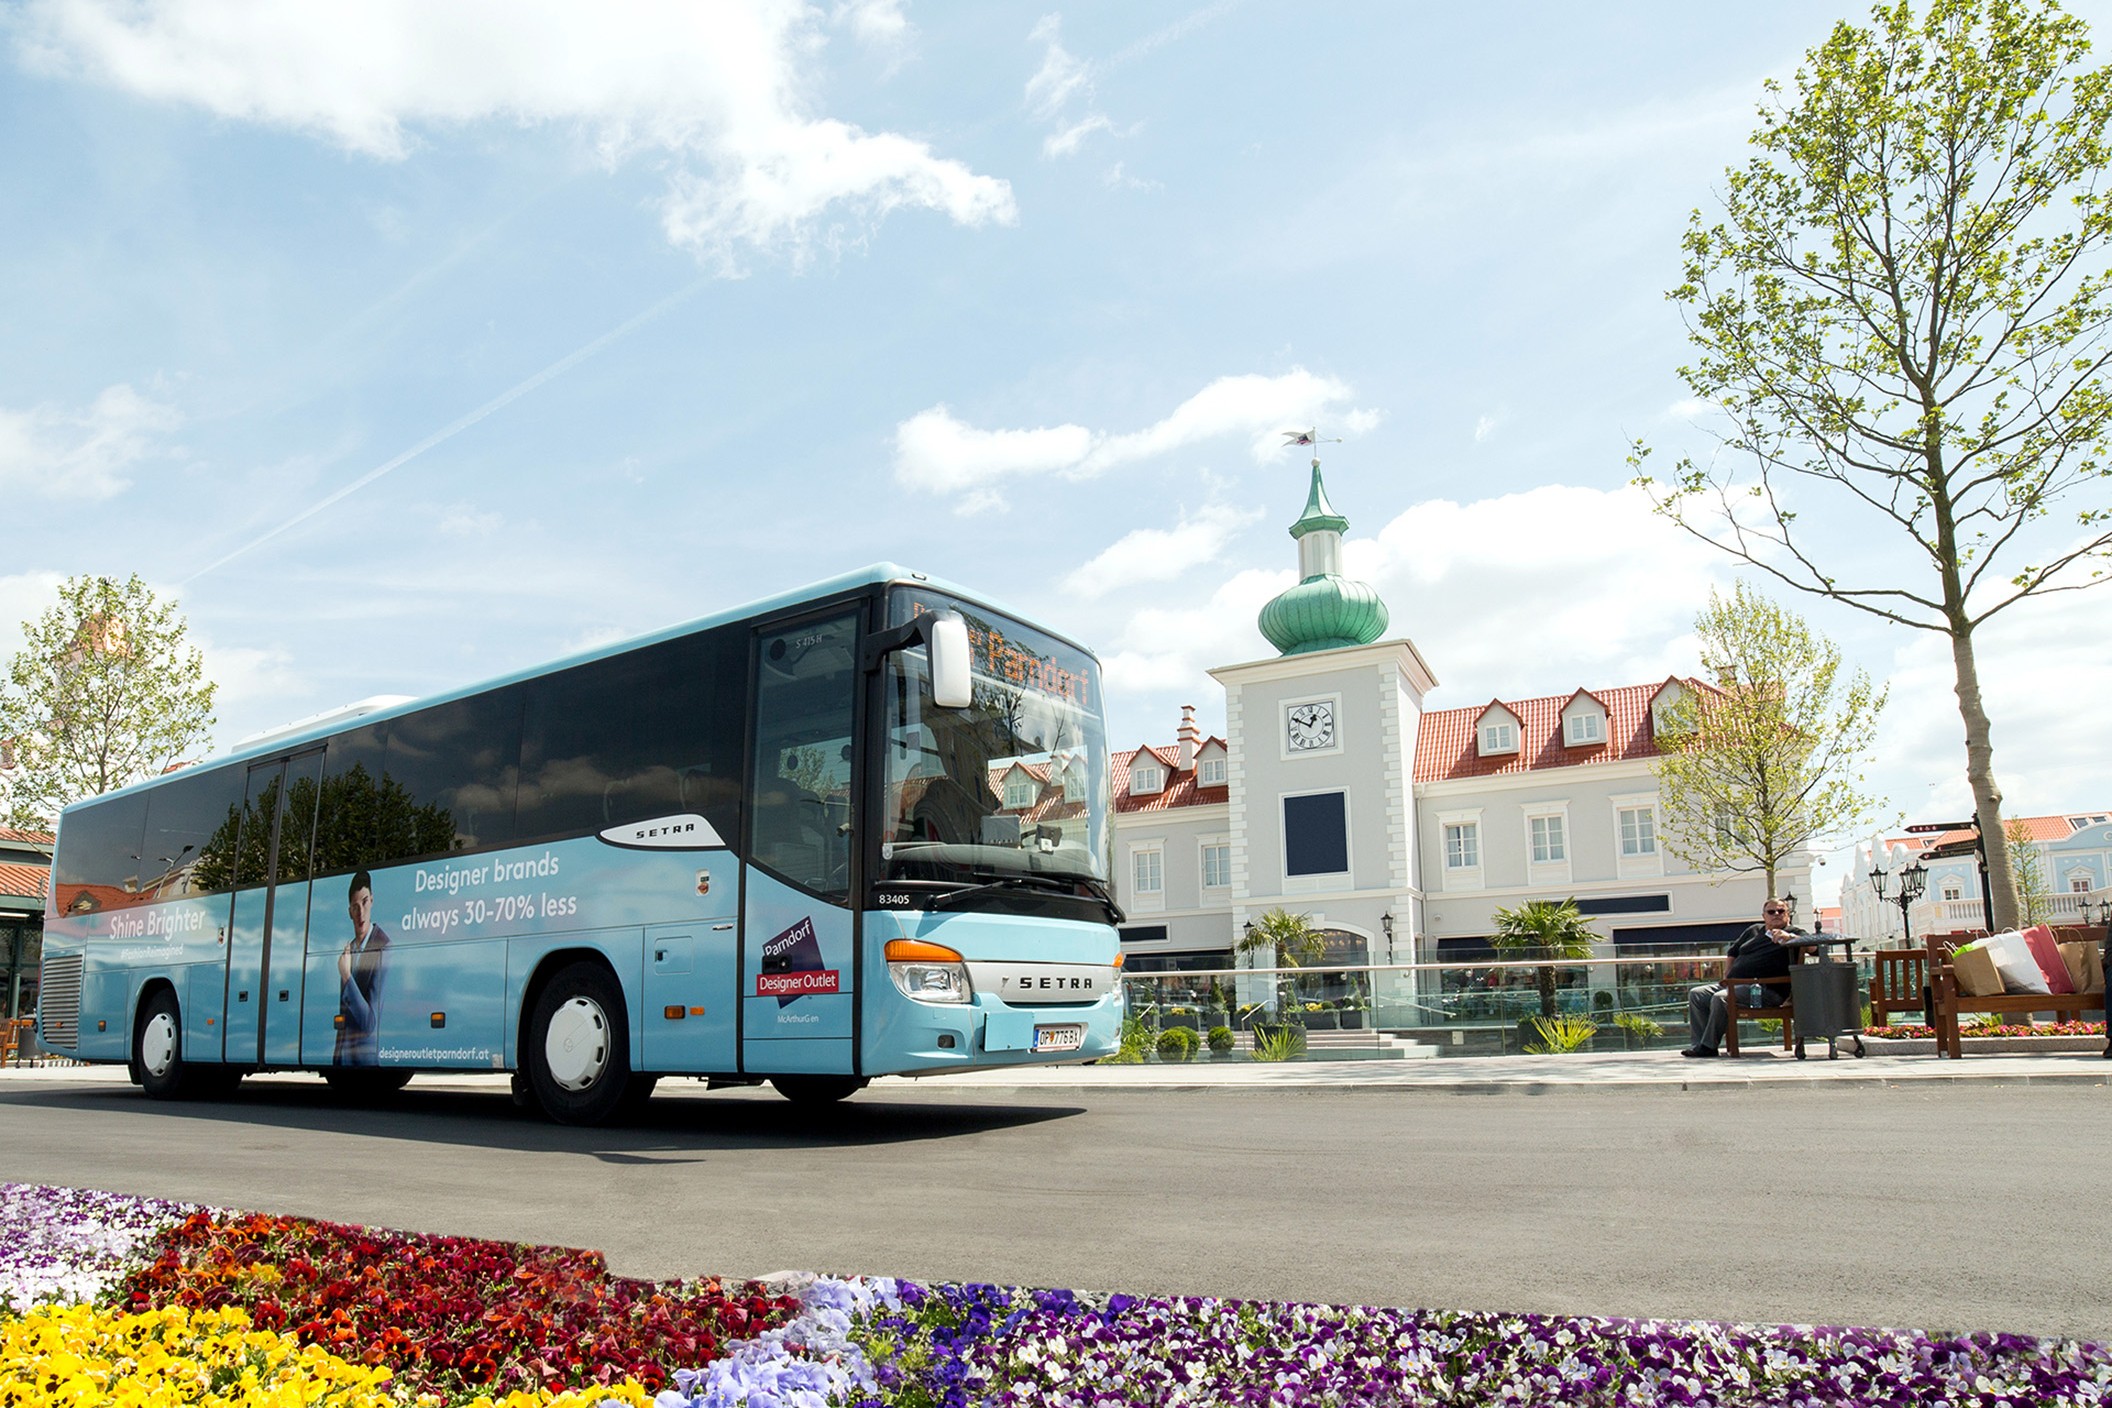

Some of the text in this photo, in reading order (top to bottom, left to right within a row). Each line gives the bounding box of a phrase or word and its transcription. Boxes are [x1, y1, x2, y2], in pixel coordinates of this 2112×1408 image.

[989, 631, 1088, 704] Parndorf
[636, 823, 694, 839] SETRA
[415, 851, 560, 895] Designer brands
[879, 894, 910, 904] 83405
[402, 892, 577, 934] always 30-70% less
[109, 907, 206, 942] Shine Brighter
[764, 920, 811, 956] Parndorf
[760, 973, 836, 993] Designer Outlet
[1020, 977, 1092, 989] SETRA
[777, 1014, 819, 1023] McArthurGen
[379, 1047, 489, 1062] designeroutletparndorf.at
